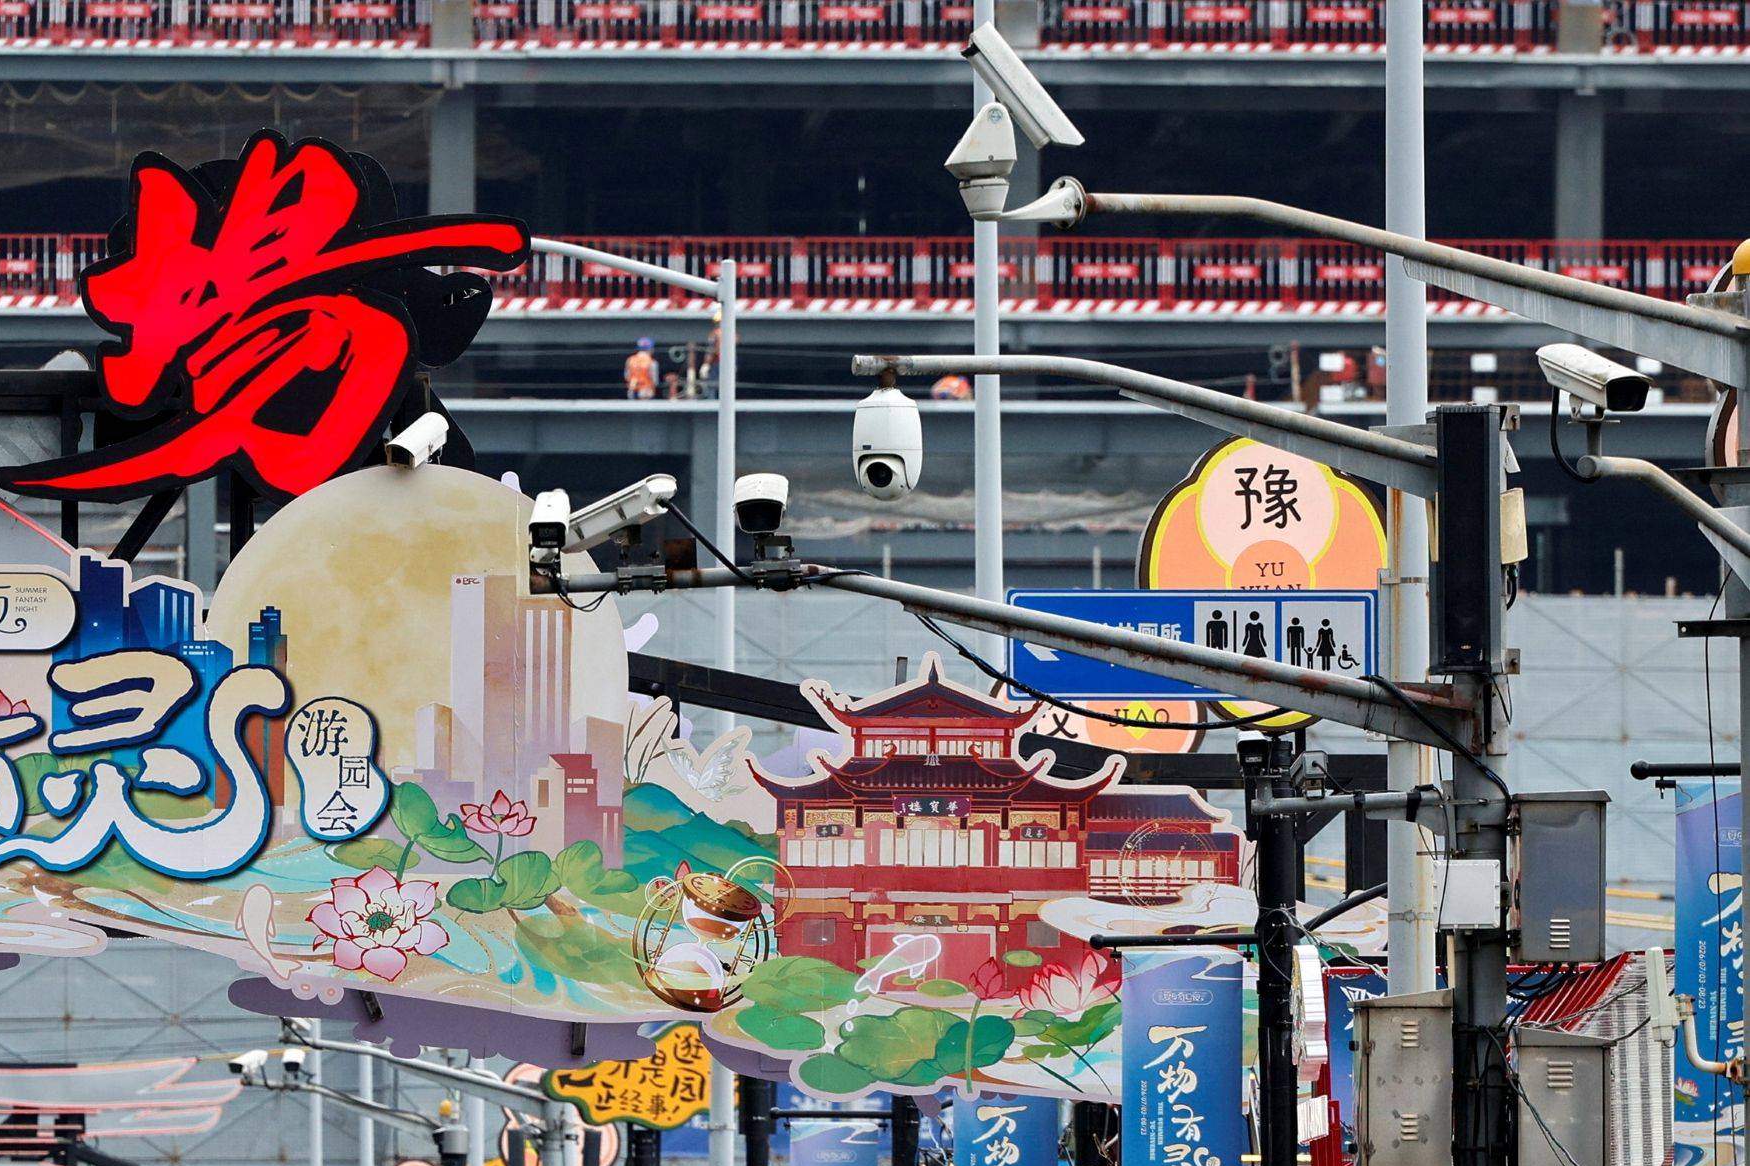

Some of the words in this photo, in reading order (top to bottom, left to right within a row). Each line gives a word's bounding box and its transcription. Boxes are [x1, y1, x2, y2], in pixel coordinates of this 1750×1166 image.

[1234, 464, 1302, 529] 豫
[1255, 562, 1285, 577] YU
[15, 605, 39, 613] NIGHT
[298, 709, 370, 833] 游园会
[1697, 940, 1706, 1010] 2026/07/03-08/23
